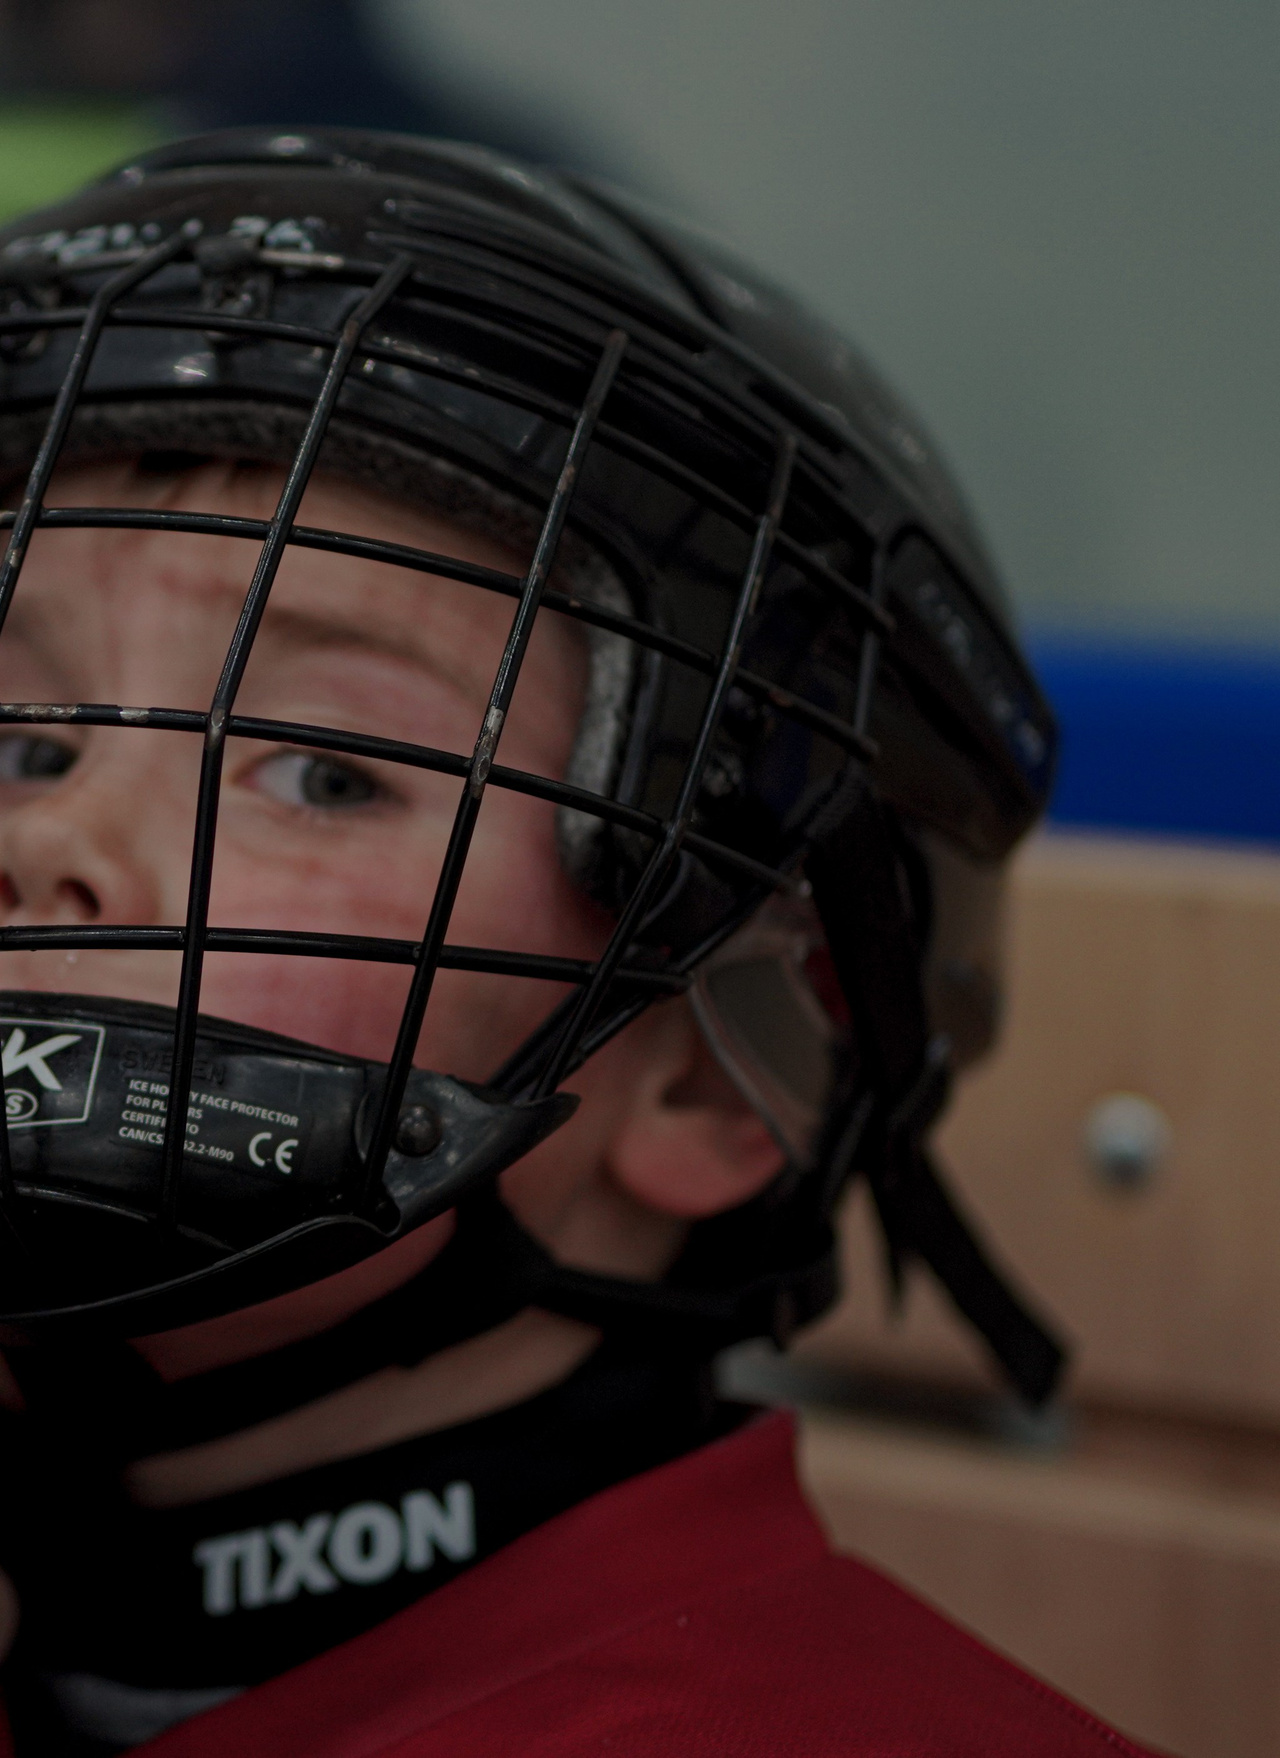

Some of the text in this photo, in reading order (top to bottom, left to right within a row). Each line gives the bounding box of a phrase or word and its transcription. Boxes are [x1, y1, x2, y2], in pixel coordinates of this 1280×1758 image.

[122, 1050, 227, 1086] SWEEN
[121, 1109, 167, 1129] CERTIFI
[126, 1094, 204, 1121] FOR PLRS
[128, 1079, 300, 1128] ICE HOY FACE PROTECTOR
[248, 1131, 300, 1175] CE
[192, 1479, 478, 1618] TIXON
